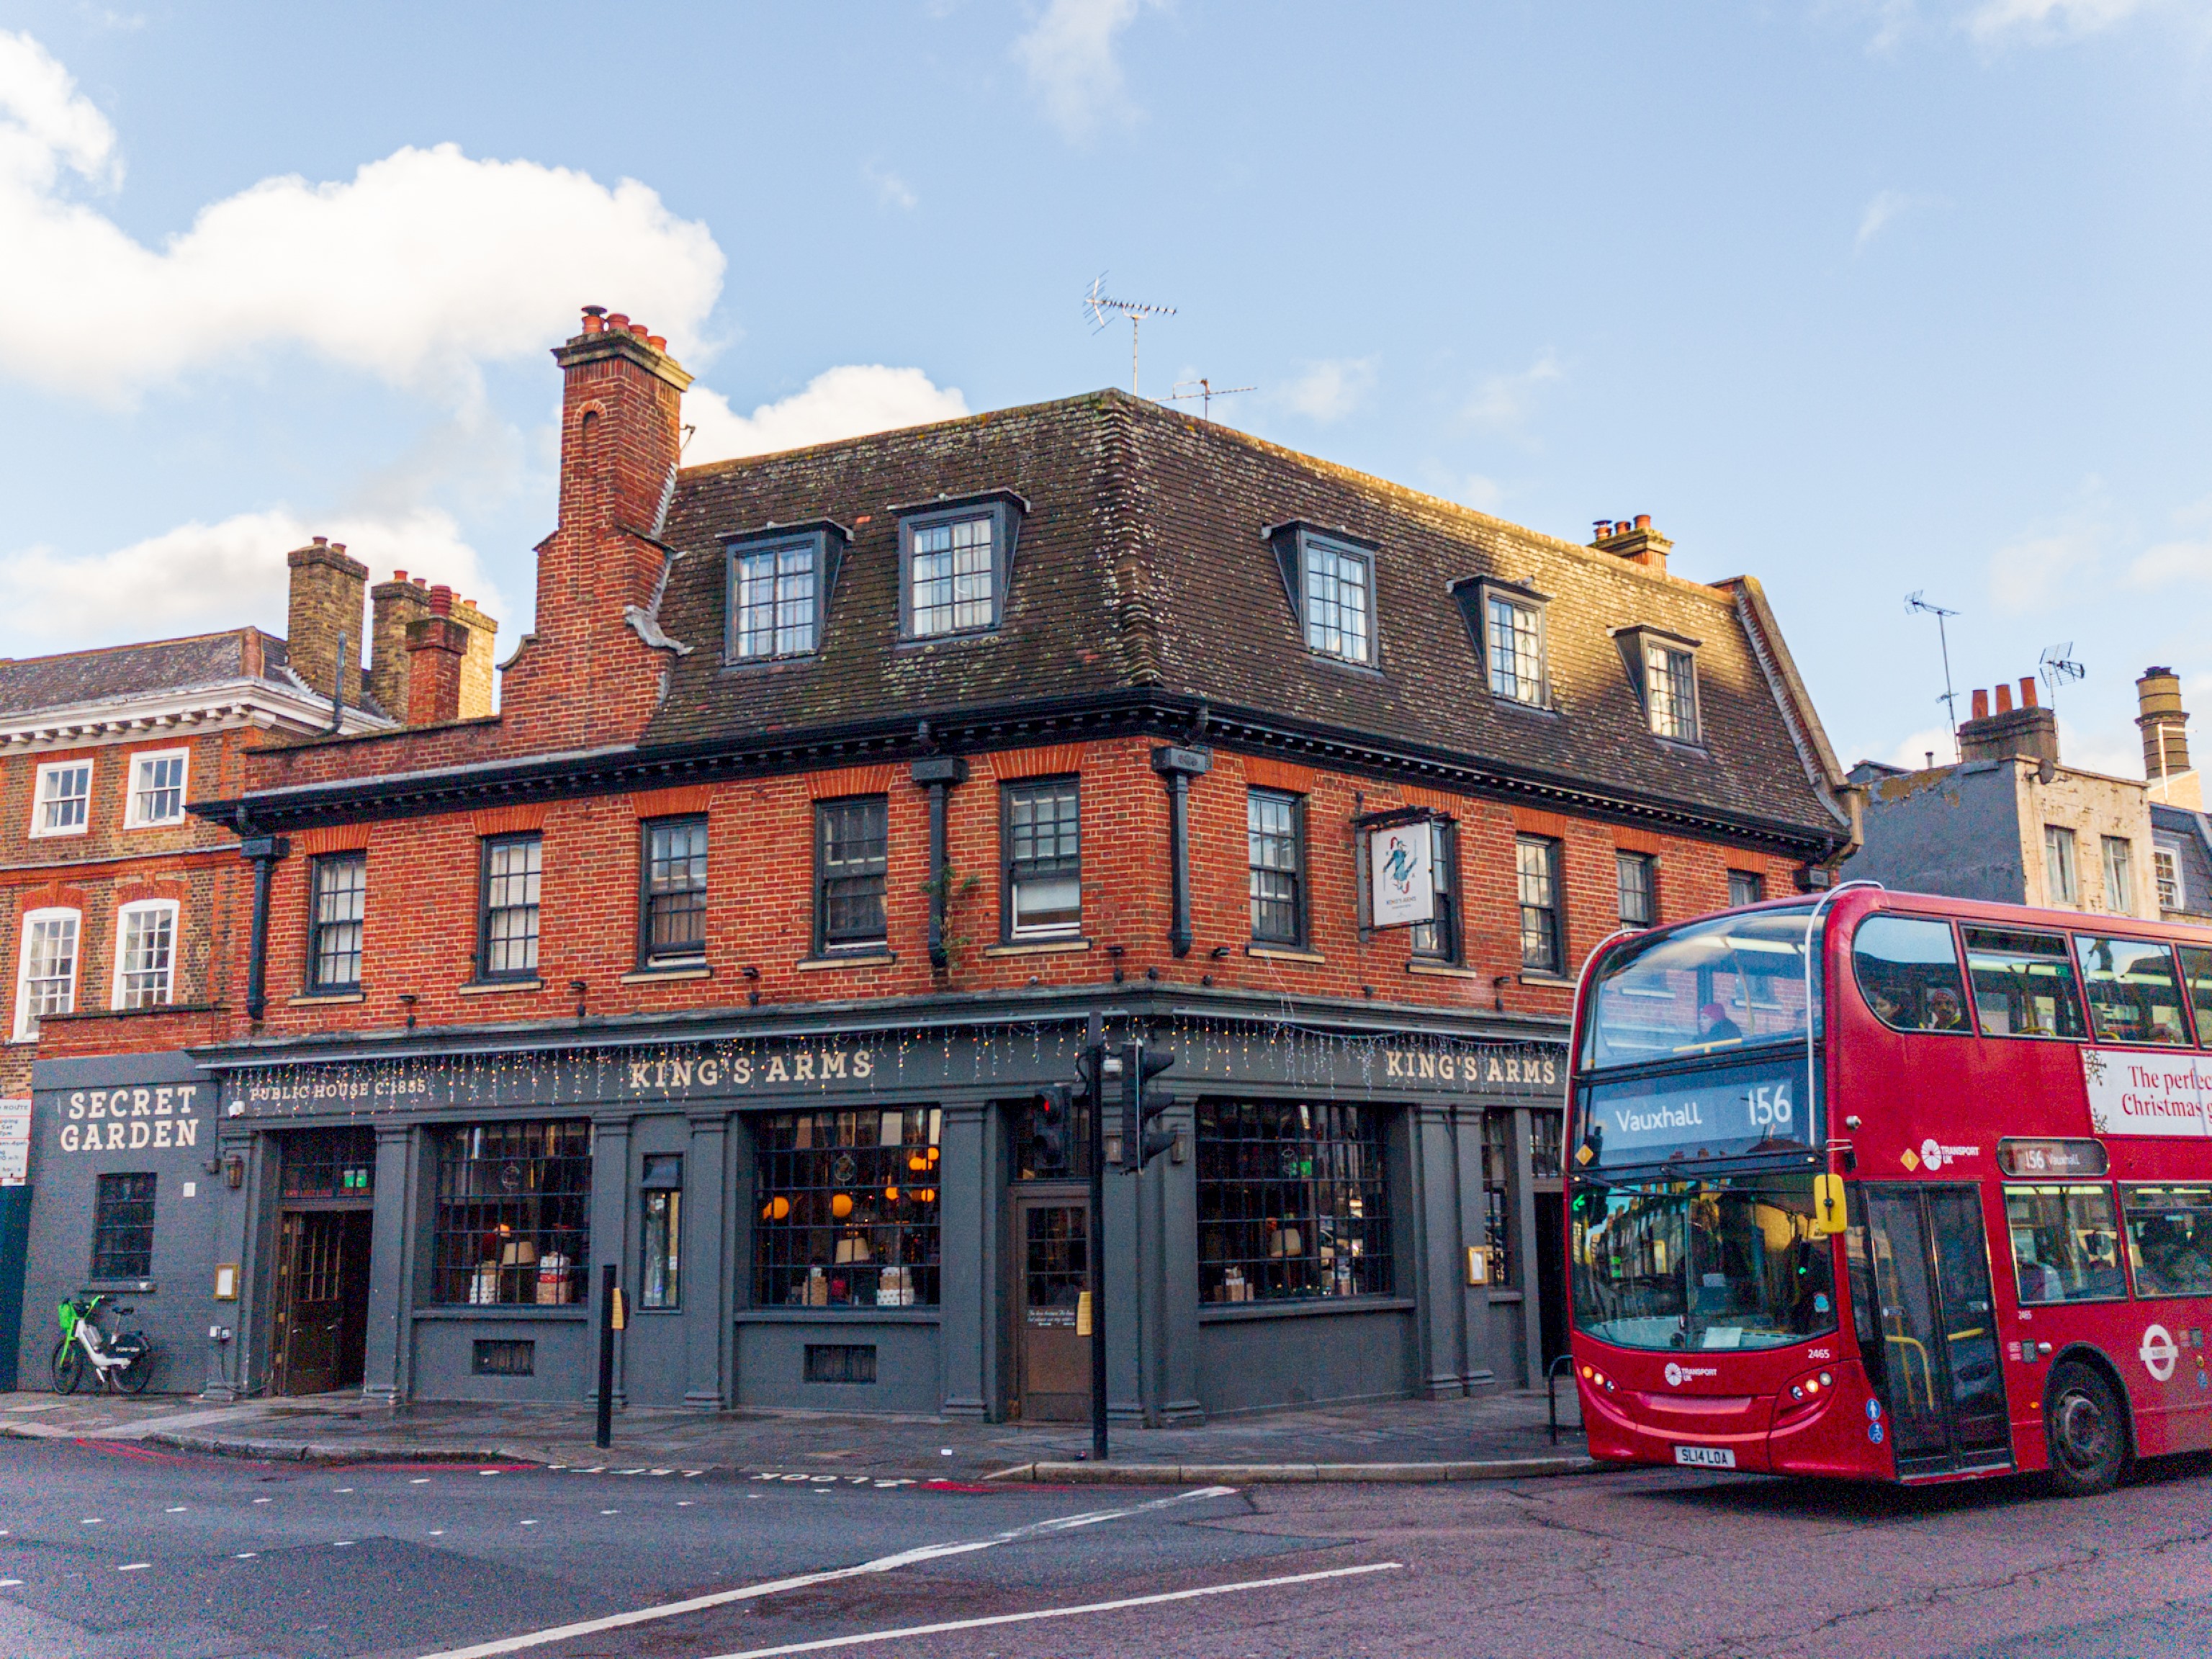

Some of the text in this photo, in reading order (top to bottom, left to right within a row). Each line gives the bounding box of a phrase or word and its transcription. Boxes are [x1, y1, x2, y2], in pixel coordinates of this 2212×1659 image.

[629, 1051, 872, 1089] KING'S ARMS
[1386, 1051, 1555, 1084] KING'S ARMS
[2128, 1066, 2159, 1088] The
[249, 1085, 309, 1101] PUBLIC
[313, 1082, 369, 1098] HOUSE
[68, 1086, 197, 1120] SECRET
[1615, 1084, 1792, 1133] Vauxhall 156
[2121, 1093, 2204, 1117] Christmas
[60, 1119, 199, 1152] GARDEN
[1941, 1146, 1979, 1156] TRANSPORT
[1943, 1155, 1954, 1165] UK
[2025, 1150, 2044, 1169] 156
[1808, 1349, 1830, 1359] 2465
[1681, 1448, 1705, 1462] SL14
